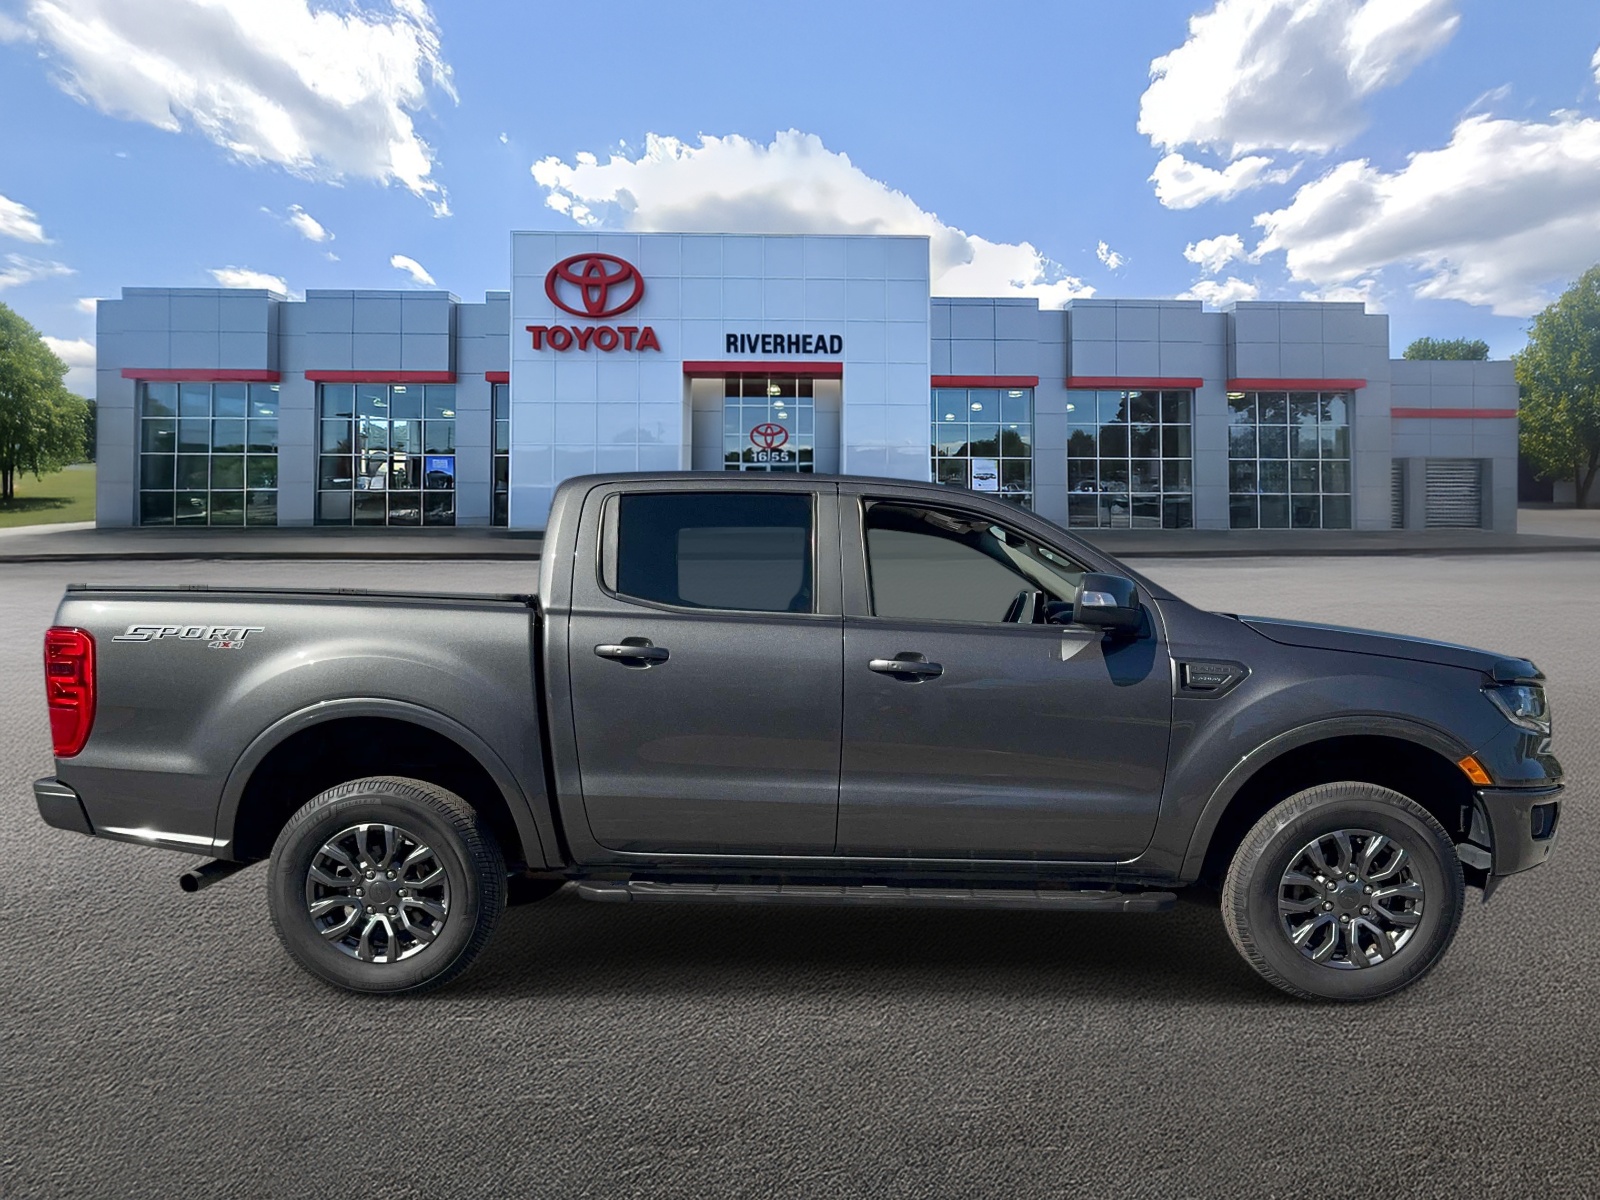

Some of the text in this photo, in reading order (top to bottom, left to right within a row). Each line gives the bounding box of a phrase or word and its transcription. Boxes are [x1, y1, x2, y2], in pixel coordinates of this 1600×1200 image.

[525, 325, 661, 352] TOYOTA
[726, 333, 843, 354] RIVERHEAD
[751, 451, 789, 462] 1655
[111, 624, 266, 643] SPORT
